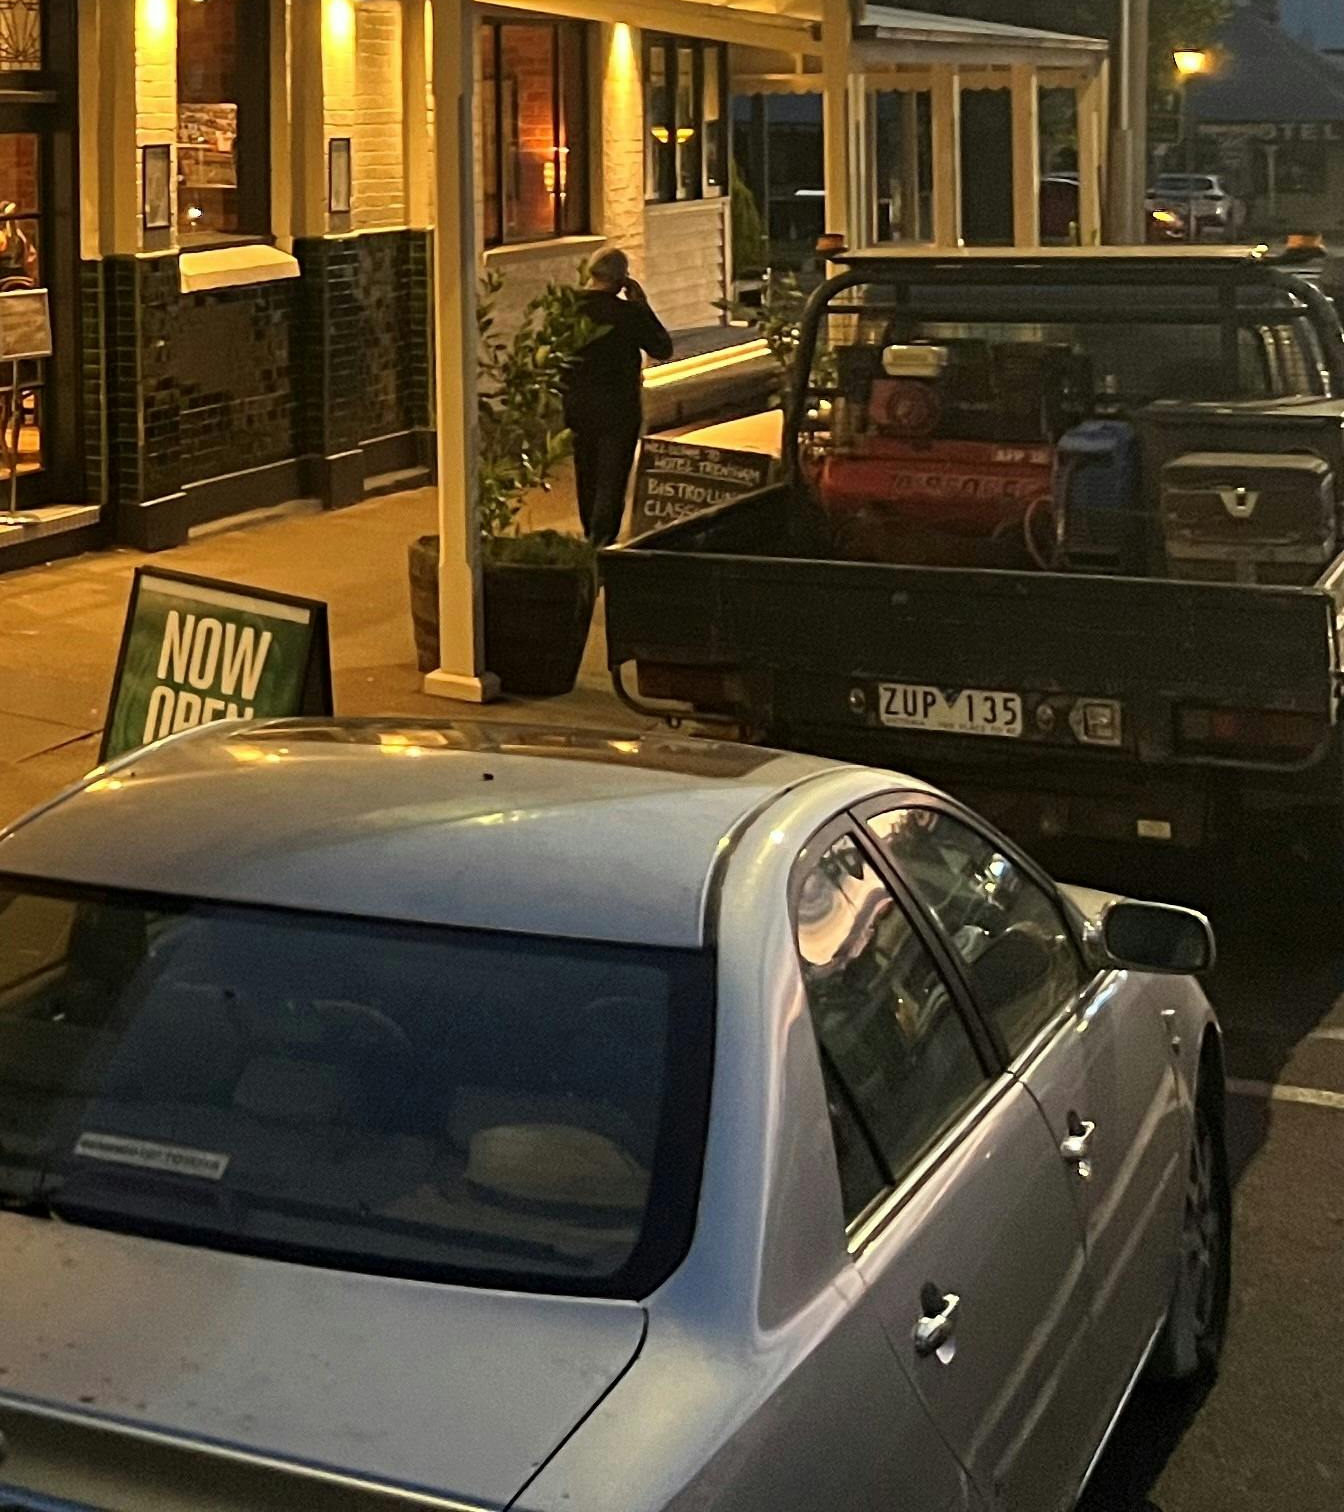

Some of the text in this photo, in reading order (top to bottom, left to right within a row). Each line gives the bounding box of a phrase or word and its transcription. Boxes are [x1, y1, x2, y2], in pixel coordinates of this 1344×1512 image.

[157, 610, 272, 700] NOW
[143, 686, 254, 744] OP
[883, 687, 1017, 725] ZUP 135
